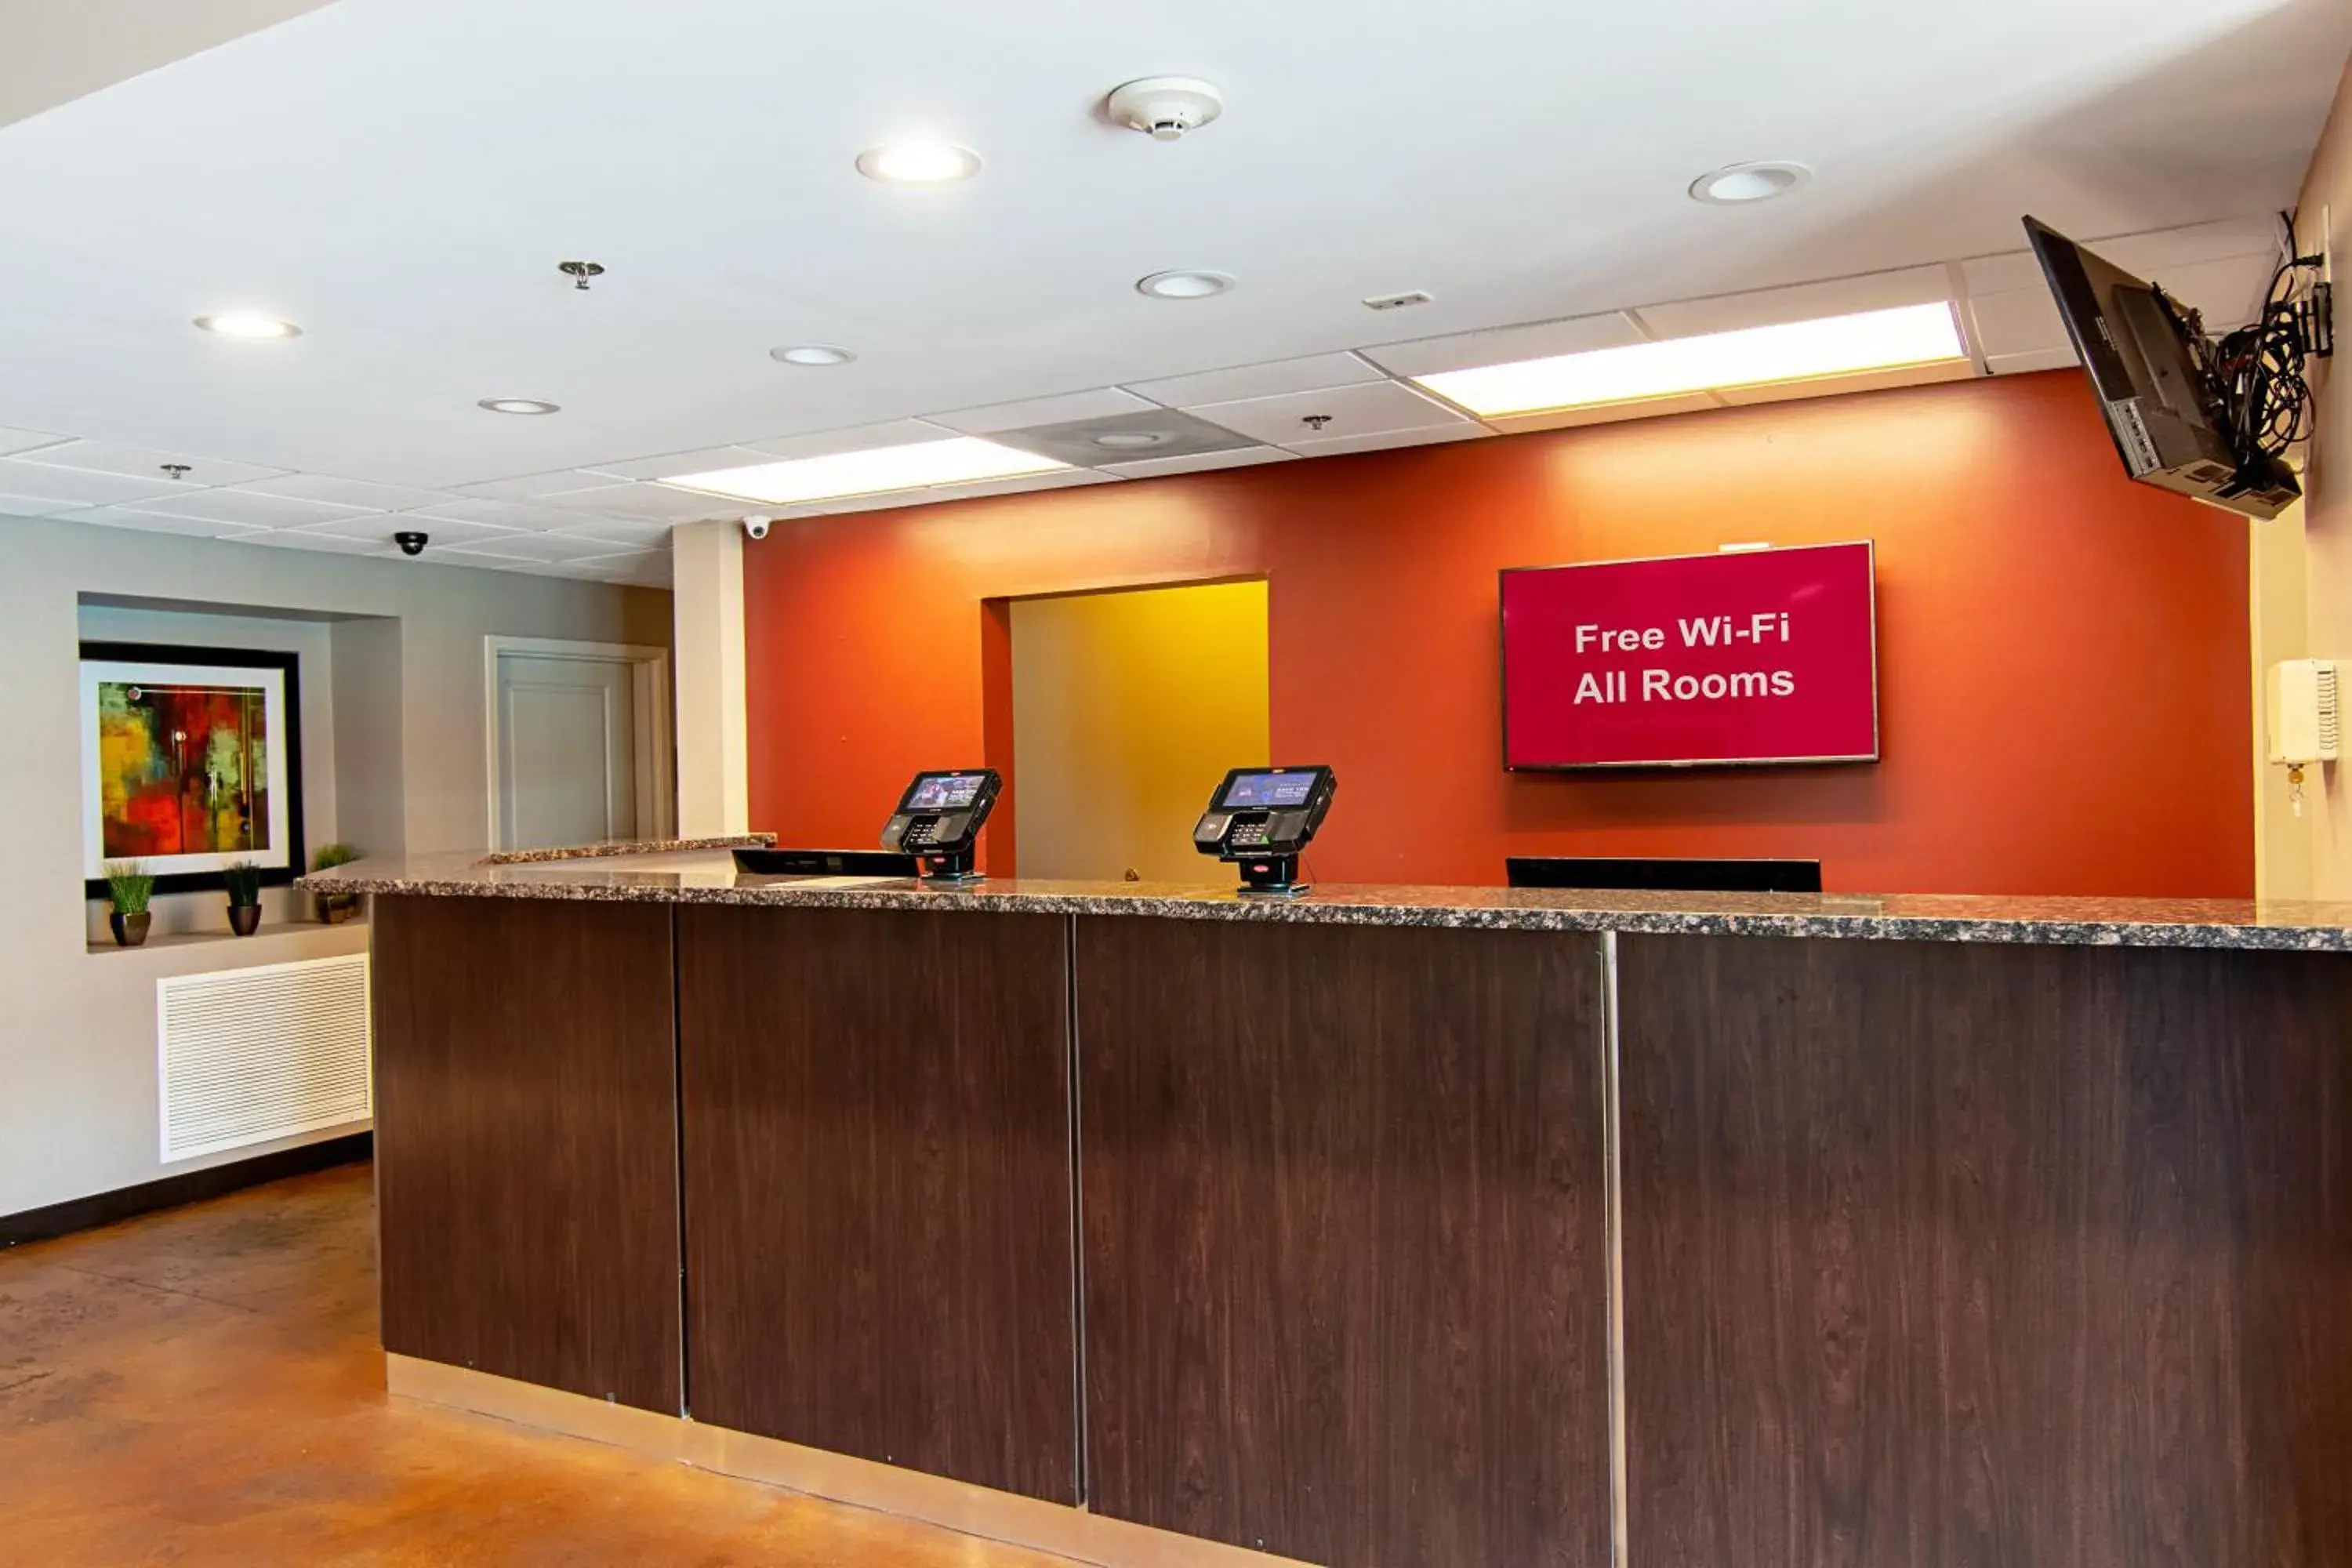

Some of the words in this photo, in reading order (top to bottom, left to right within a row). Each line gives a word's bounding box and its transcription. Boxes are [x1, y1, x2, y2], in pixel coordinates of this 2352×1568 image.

[1576, 624, 1664, 653] Free
[1678, 612, 1789, 647] Wi-Fi
[1573, 670, 1627, 704] All
[1642, 669, 1795, 702] Rooms
